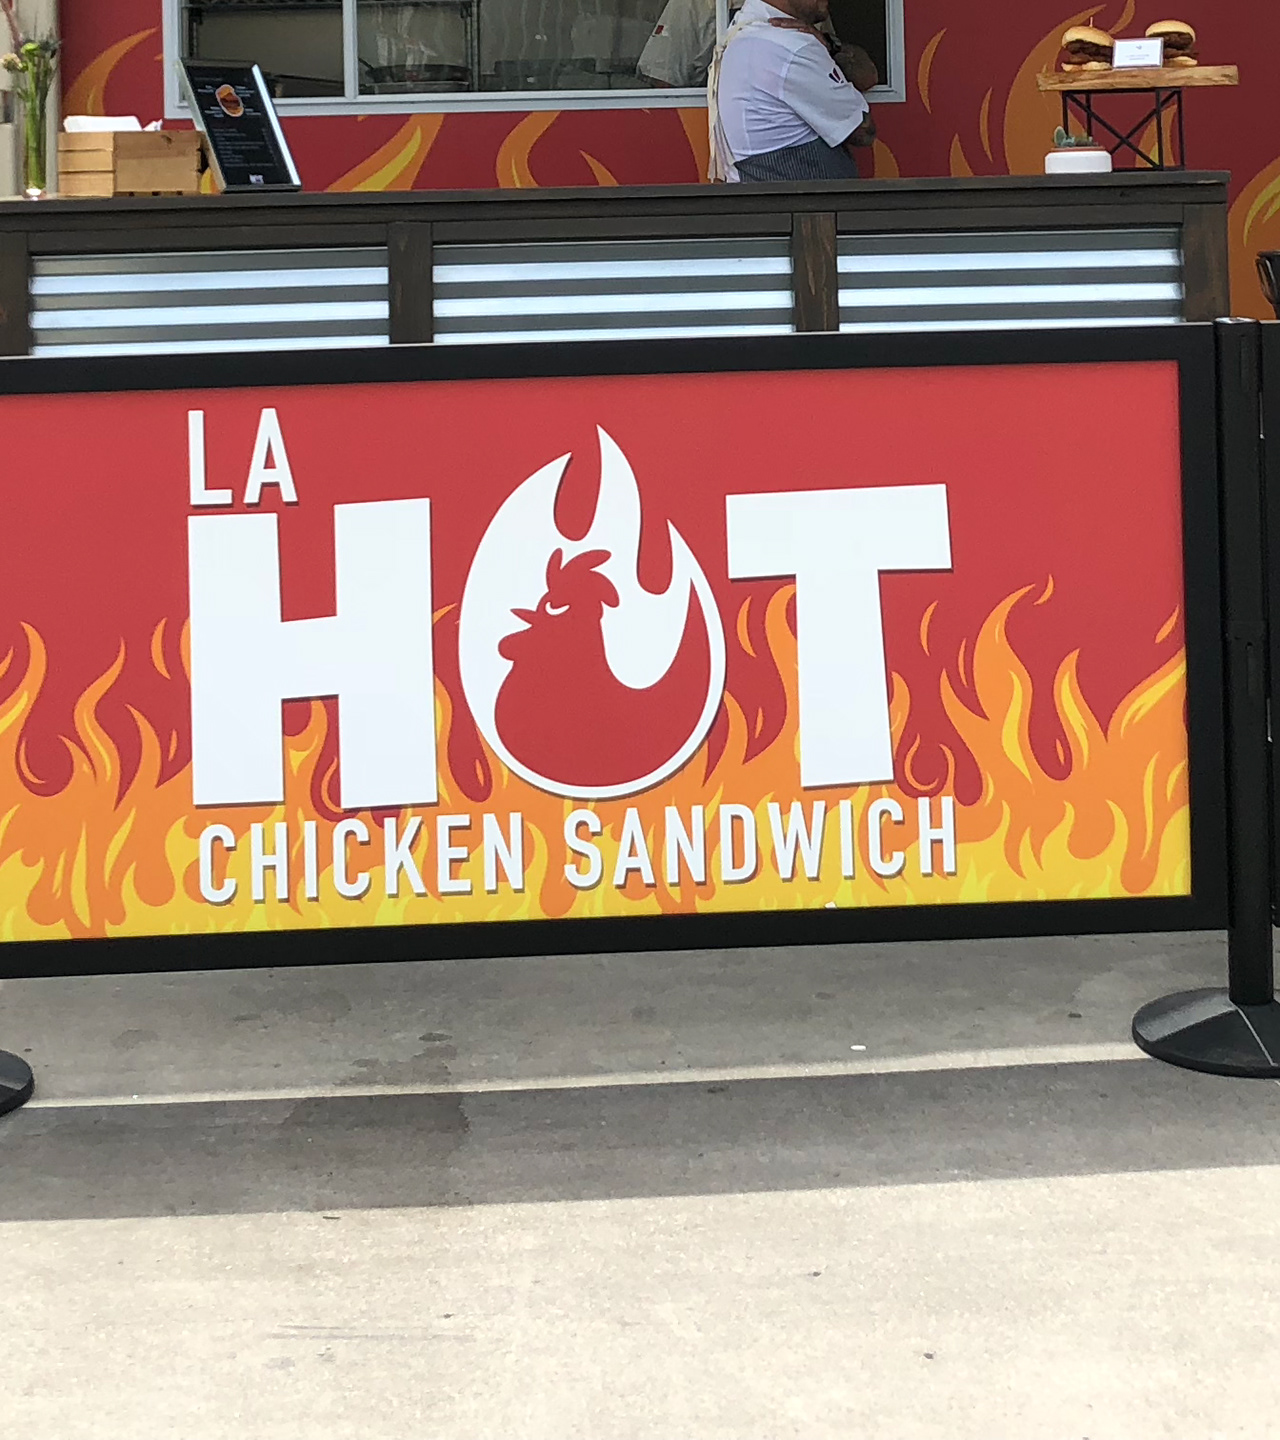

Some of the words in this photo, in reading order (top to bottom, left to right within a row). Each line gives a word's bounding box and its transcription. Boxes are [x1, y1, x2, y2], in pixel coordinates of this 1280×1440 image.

[188, 407, 299, 506] LA
[187, 424, 953, 809] HOT
[199, 812, 525, 903] CHICKEN
[563, 795, 957, 888] SANDWICH
